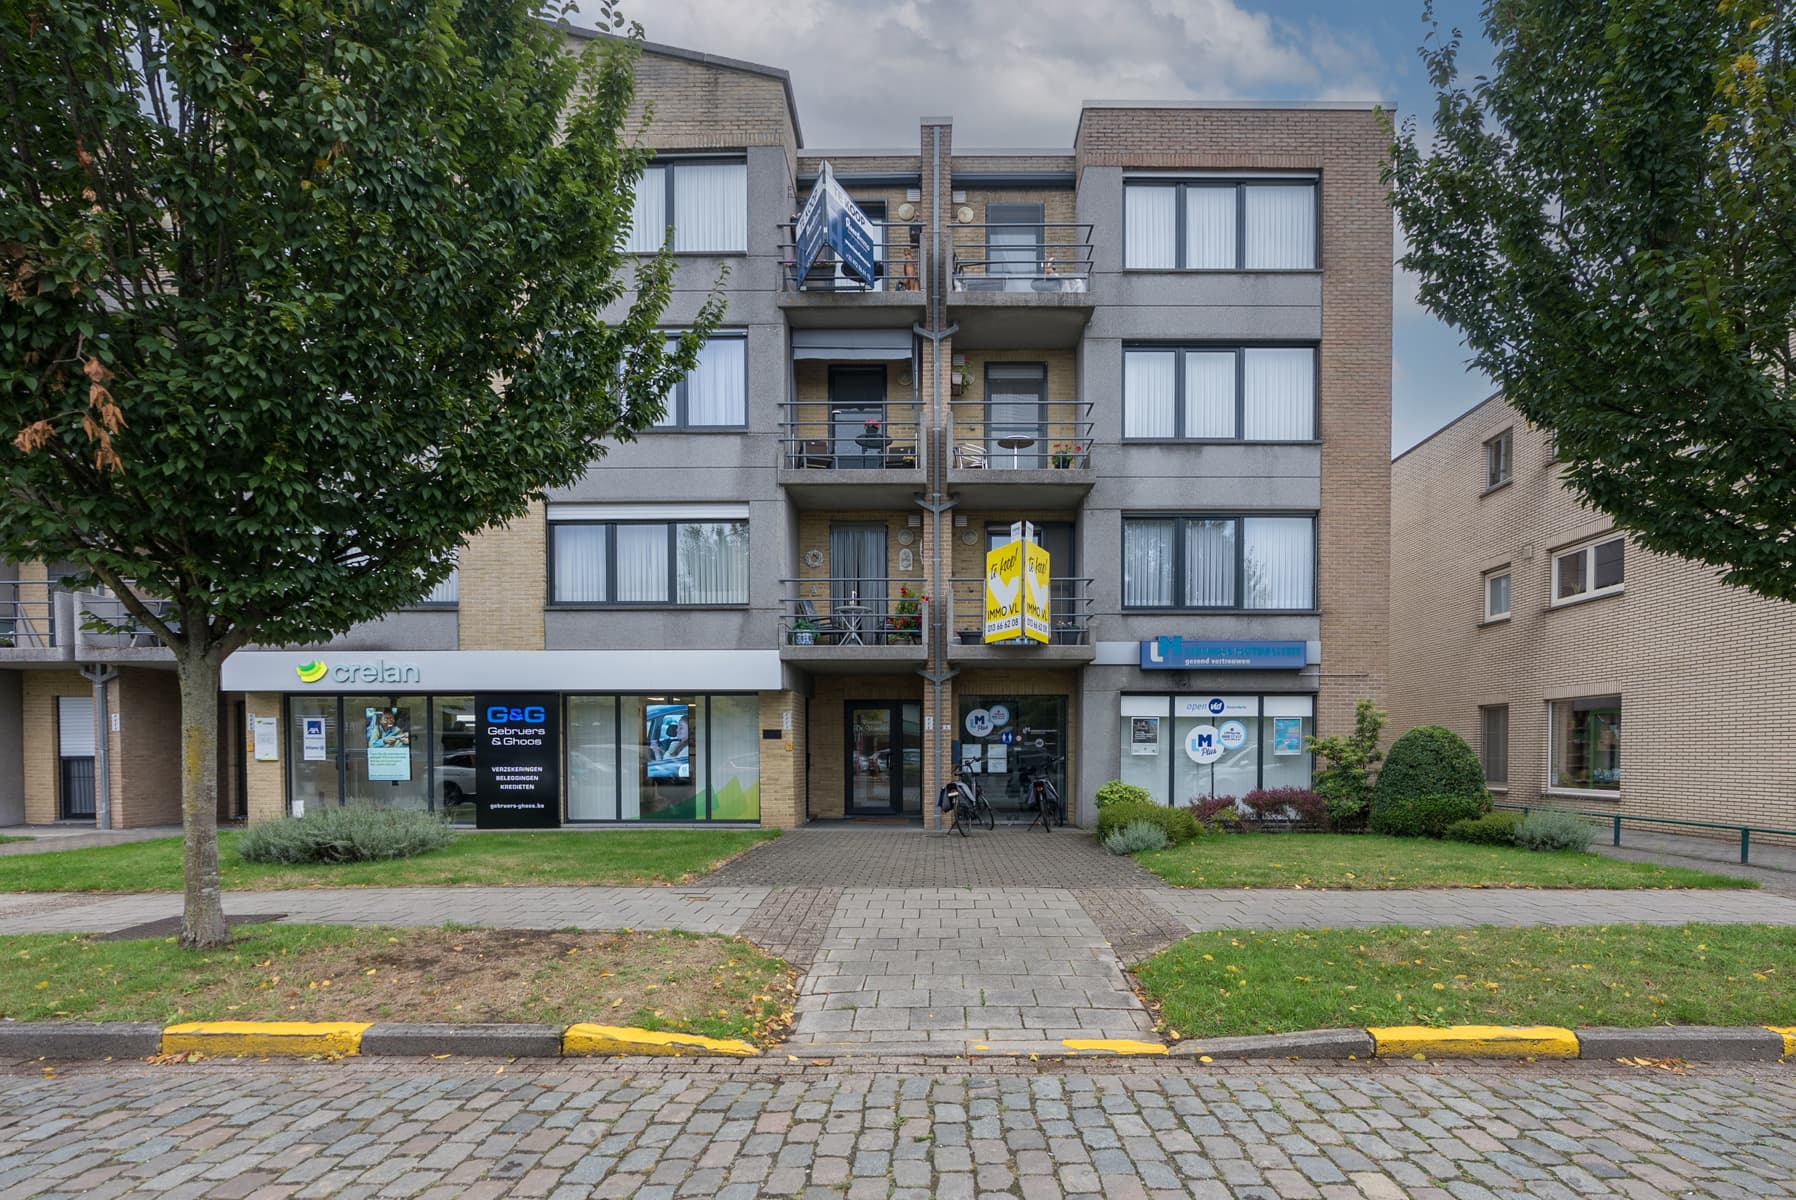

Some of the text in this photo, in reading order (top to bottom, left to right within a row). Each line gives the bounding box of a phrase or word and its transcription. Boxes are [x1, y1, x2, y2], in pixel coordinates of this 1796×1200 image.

[846, 200, 866, 226] KOOP
[990, 546, 1019, 580] te koop!
[1028, 556, 1049, 575] te koop!
[987, 602, 1020, 621] IMMO VL
[1026, 602, 1048, 622] IMMO VL
[332, 659, 420, 684] crelan
[487, 705, 546, 723] G&G
[1186, 703, 1208, 712] open
[487, 727, 546, 736] Gebruers
[491, 737, 542, 746] & Ghoos
[1191, 734, 1213, 753] LM
[1200, 747, 1217, 757] Plus
